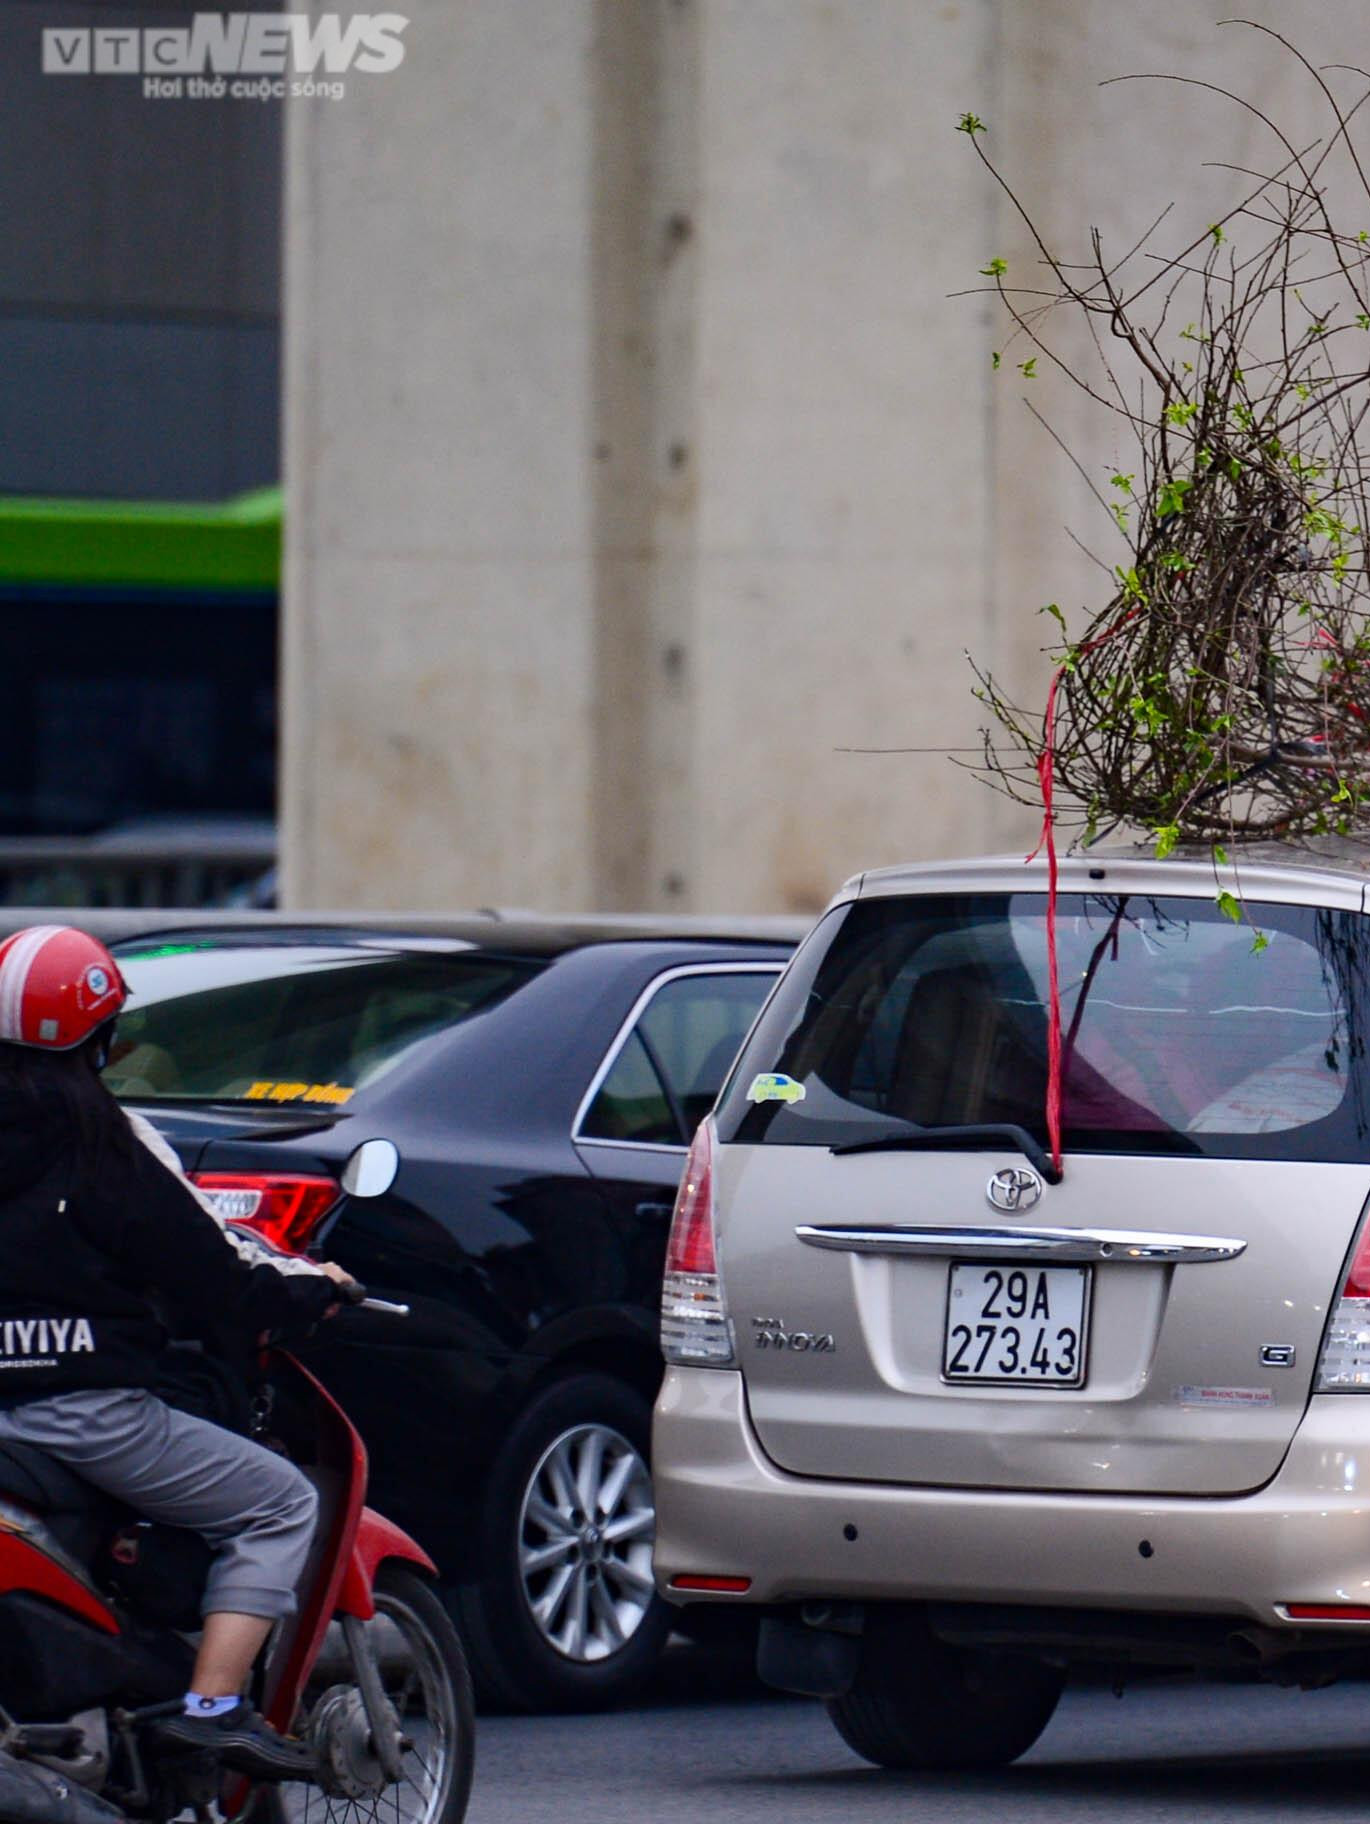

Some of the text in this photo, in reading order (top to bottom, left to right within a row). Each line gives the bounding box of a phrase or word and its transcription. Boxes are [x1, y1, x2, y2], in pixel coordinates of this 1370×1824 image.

[981, 1270, 1050, 1320] 29A
[0, 1318, 95, 1355] IYIYA
[949, 1324, 1077, 1375] 273.43
